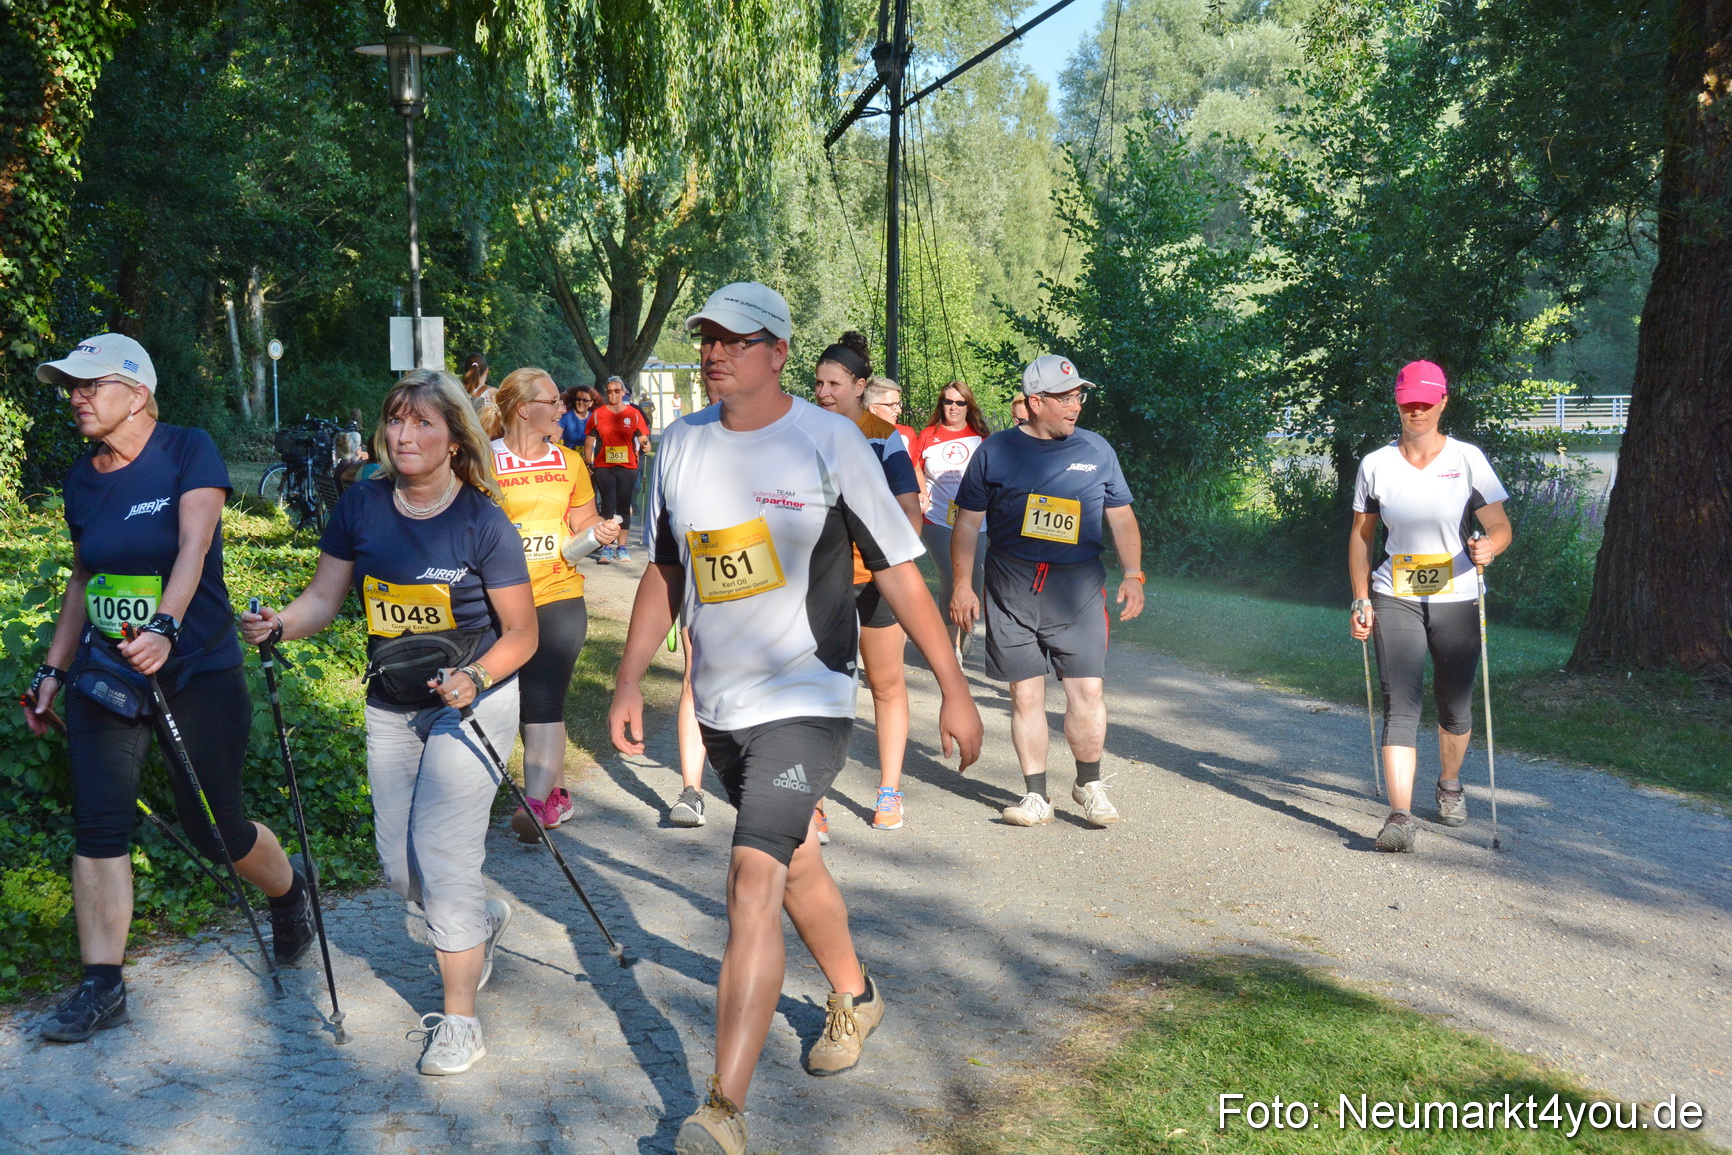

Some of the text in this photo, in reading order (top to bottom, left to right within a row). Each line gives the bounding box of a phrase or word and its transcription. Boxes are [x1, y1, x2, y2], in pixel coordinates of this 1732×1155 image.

[498, 472, 569, 488] MAX BÖGL
[762, 497, 805, 508] partner
[1033, 510, 1074, 530] 1106
[705, 550, 753, 581] 761
[1406, 569, 1439, 584] 762
[93, 596, 149, 621] 1060
[376, 602, 441, 624] 1048
[165, 713, 182, 741] LEKI
[772, 778, 811, 793] adidas
